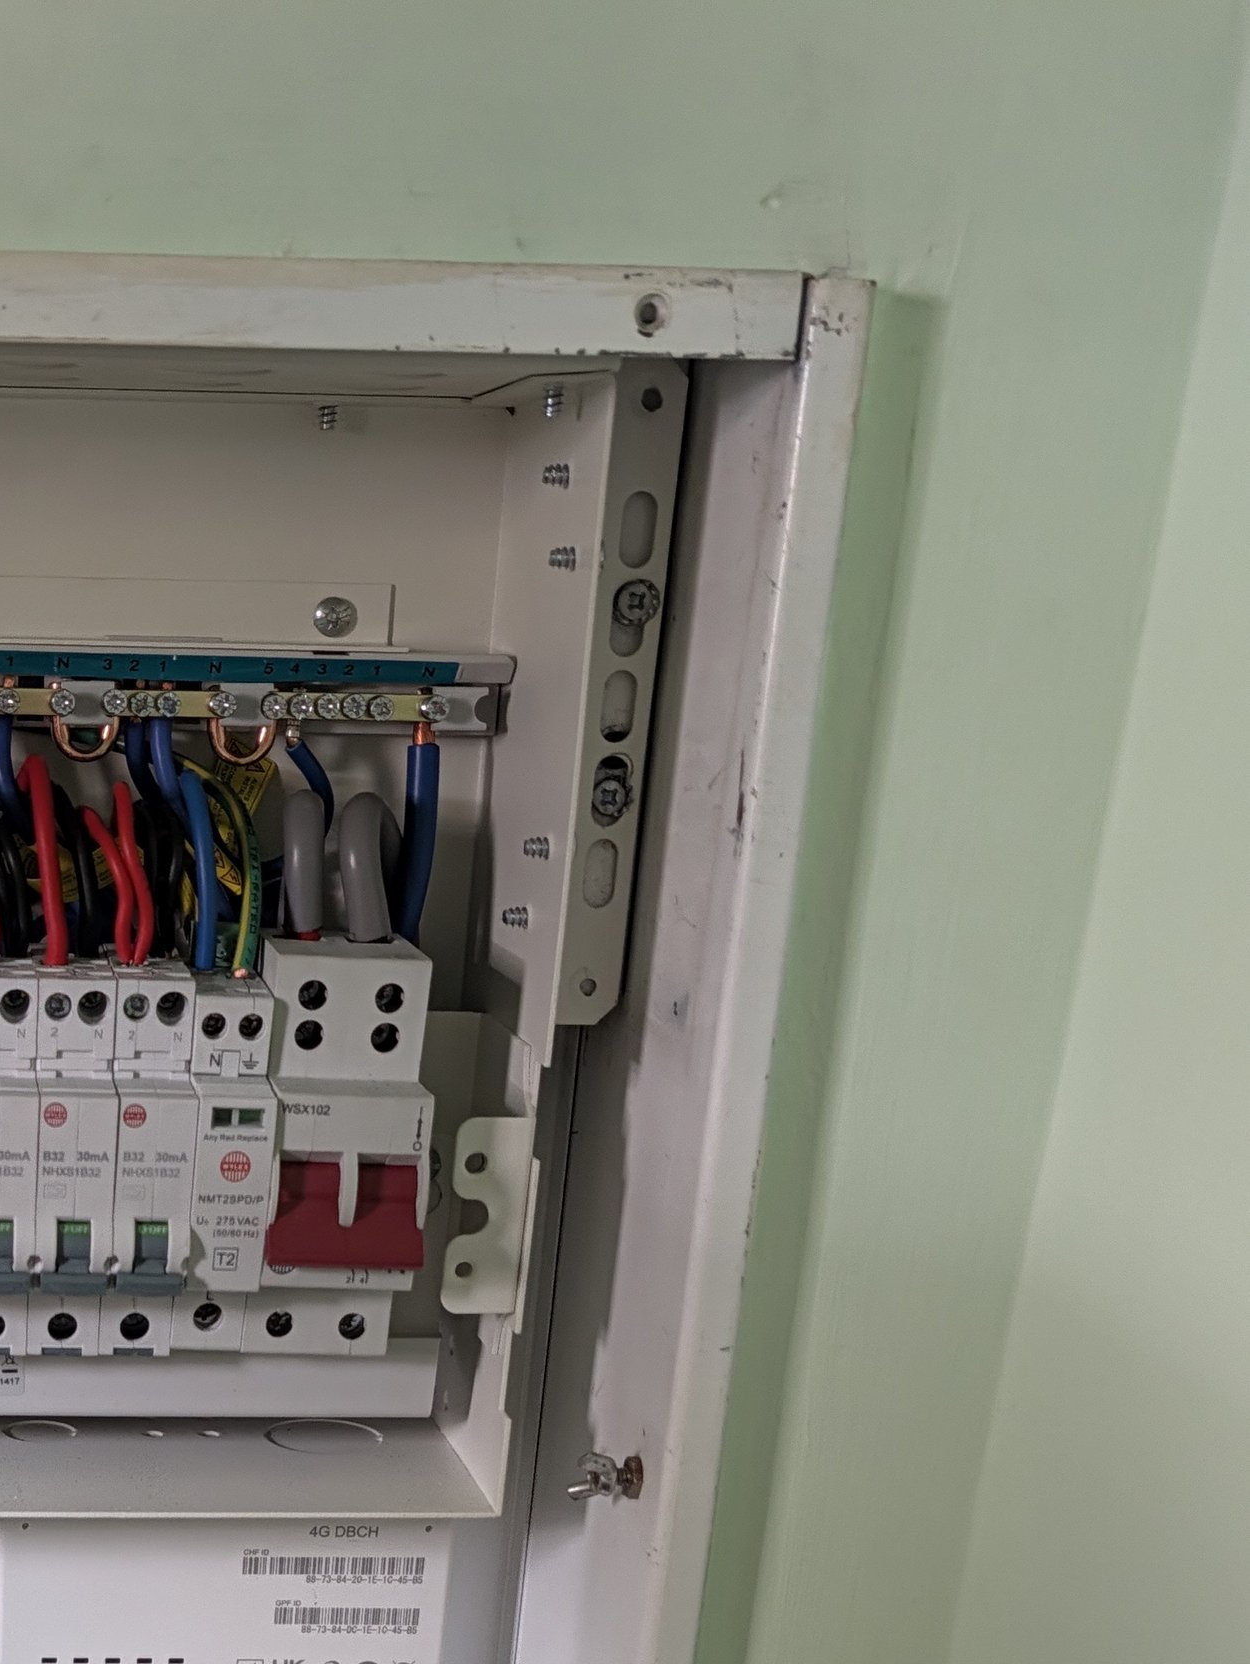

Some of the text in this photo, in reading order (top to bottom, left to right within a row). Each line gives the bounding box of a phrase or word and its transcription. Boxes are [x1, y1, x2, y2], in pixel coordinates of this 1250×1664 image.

[6, 655, 14, 667] 1
[56, 656, 70, 670] N
[102, 657, 113, 671] 3
[129, 658, 140, 672] 2
[158, 659, 167, 673] 1
[208, 661, 222, 674] N
[263, 661, 274, 675] 5
[289, 661, 301, 675] 4
[316, 661, 327, 675] 3
[343, 662, 354, 676] 2
[372, 662, 382, 676] 1
[422, 664, 436, 679] N
[209, 1053, 221, 1067] N
[282, 1102, 331, 1117] WSX102
[43, 1150, 110, 1163] B32 30mA
[123, 1151, 188, 1163] B32 30mA
[238, 1217, 259, 1226] VAC
[217, 1253, 235, 1266] T2
[309, 1526, 379, 1538] 4G DBCH
